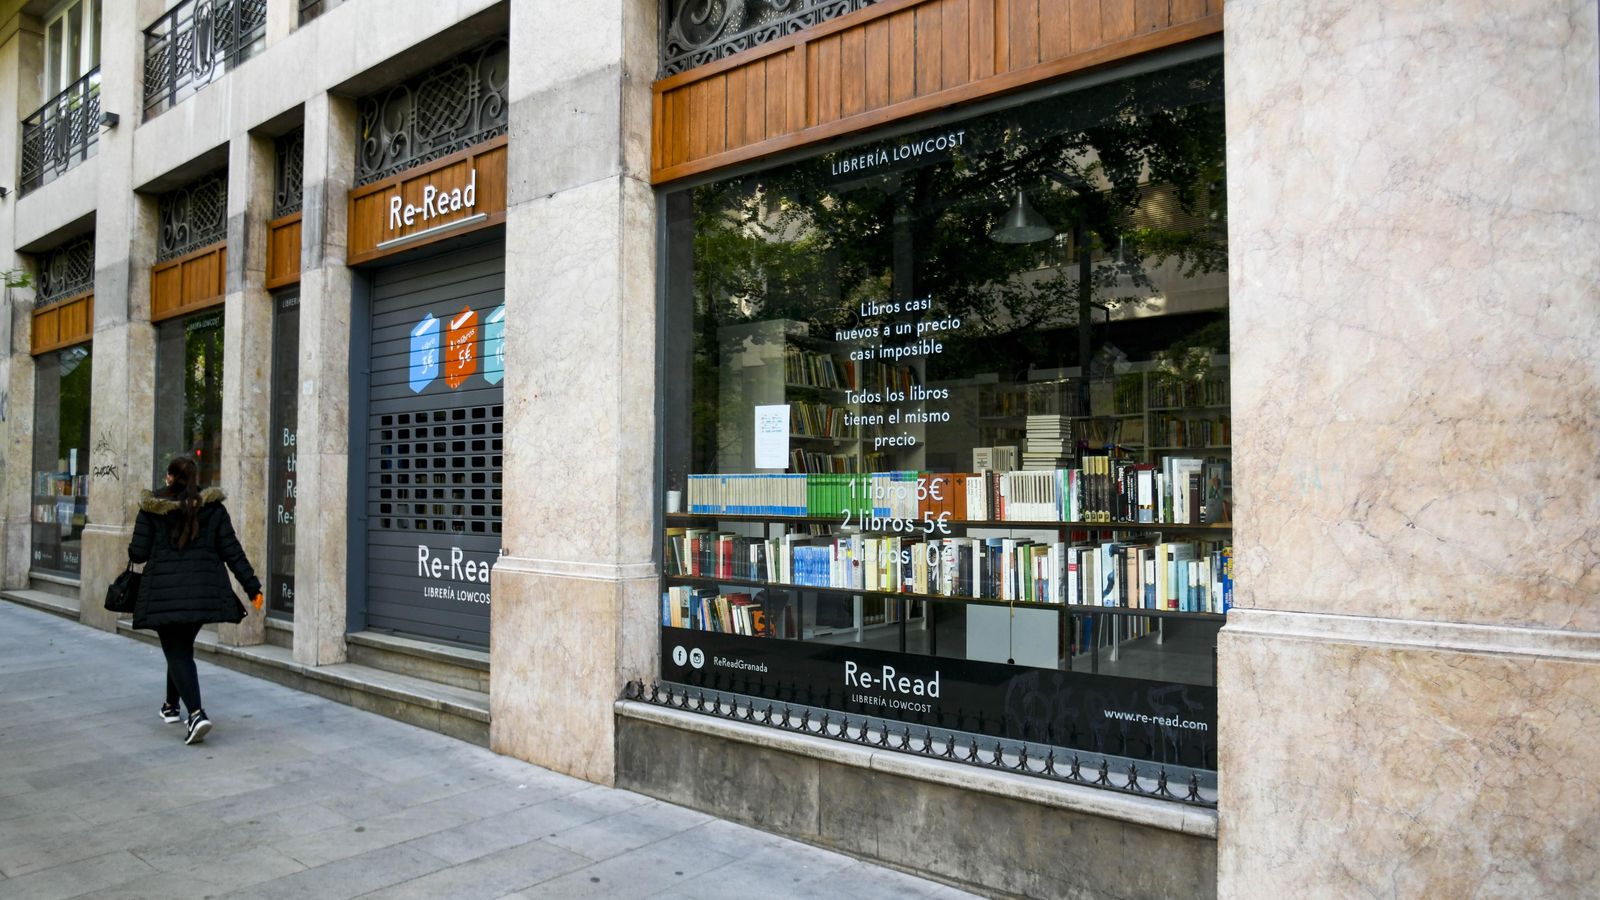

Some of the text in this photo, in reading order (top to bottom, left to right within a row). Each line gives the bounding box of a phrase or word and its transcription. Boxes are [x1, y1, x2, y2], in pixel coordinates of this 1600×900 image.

[832, 131, 965, 176] LIBRERÍA LOWCOST
[389, 168, 476, 230] Re-Read
[861, 294, 931, 317] Libros casi
[835, 314, 960, 341] nuevos a un precio
[850, 338, 943, 361] casi imposible
[845, 385, 949, 404] Todos los libros
[844, 409, 950, 426] tienen el mismo
[283, 427, 297, 446] Be
[874, 432, 916, 451] precio
[849, 478, 856, 499] 1
[863, 477, 906, 500] libro
[917, 478, 944, 501] 3€
[278, 504, 296, 524] Re-
[841, 509, 952, 534] 2 libros 5€
[424, 586, 455, 599] LIBRERÍA
[713, 656, 768, 673] ReReadGranada
[845, 660, 940, 698] Re-Read
[851, 694, 932, 713] LIBRERÍA LOWCOST
[1104, 709, 1208, 731] www.re-read.com
